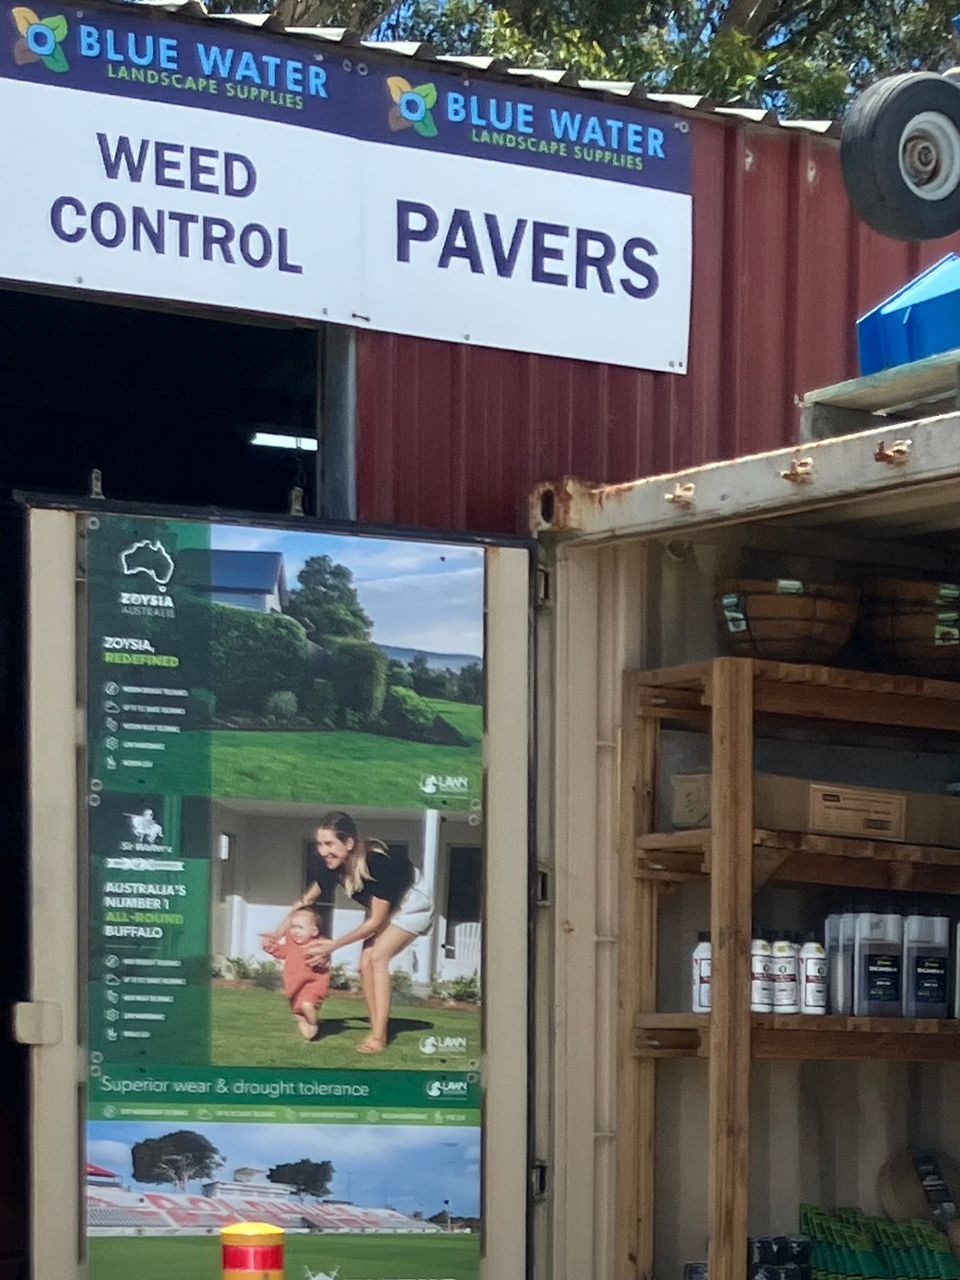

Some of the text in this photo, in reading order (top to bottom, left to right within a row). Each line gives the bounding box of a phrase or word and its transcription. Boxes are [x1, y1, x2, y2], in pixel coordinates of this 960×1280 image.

[77, 24, 331, 100] BLUE WATER
[105, 63, 305, 111] LANDSCAPE SUPPLIES
[446, 91, 668, 159] BLUE WATER
[95, 131, 259, 199] WEED
[470, 128, 645, 172] LANDSCAPE SUPPLIES
[49, 195, 305, 277] CONTROL
[395, 198, 661, 300] PAVERS
[120, 592, 175, 608] ZOYSIA
[103, 652, 180, 668] REDEFINED
[103, 882, 187, 896] AUSTRALIA'S
[103, 896, 161, 909] NUMBER
[103, 925, 164, 938] BUFFALO
[104, 911, 184, 924] ALL-ROUND
[100, 1075, 370, 1099] Superior wear & drought tolerance
